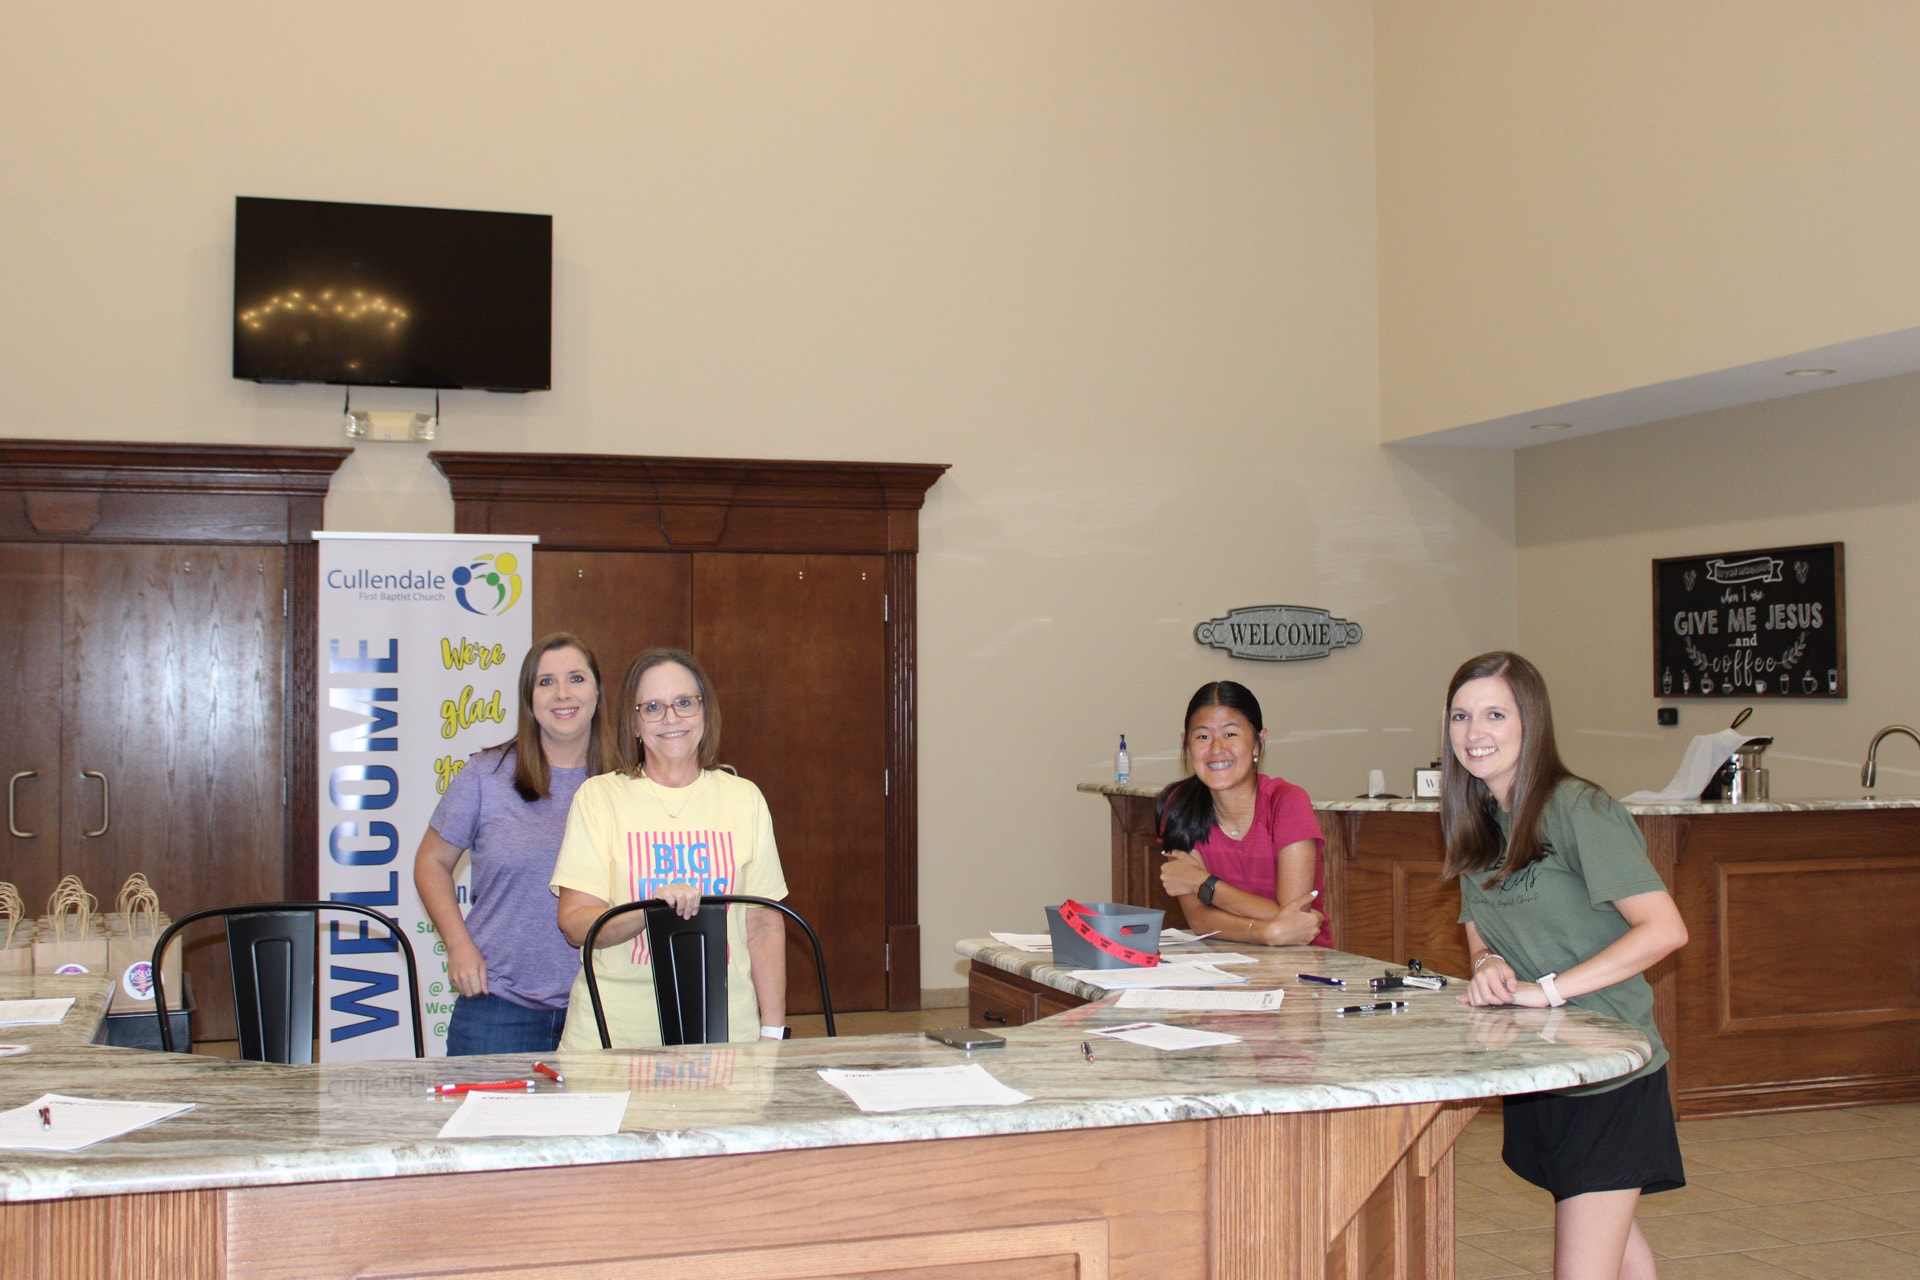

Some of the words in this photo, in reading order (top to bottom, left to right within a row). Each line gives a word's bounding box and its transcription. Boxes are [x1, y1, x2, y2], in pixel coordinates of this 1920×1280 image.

[327, 568, 446, 590] Cullendale
[359, 592, 379, 602] First
[380, 592, 411, 603] Baptist
[412, 592, 445, 602] Church
[1229, 623, 1331, 646] WELCOME
[1673, 609, 1719, 636] GIVE
[1727, 606, 1757, 633] ME
[1764, 602, 1824, 631] JESUS
[440, 636, 506, 671] We're
[1712, 649, 1776, 687] coffee
[440, 685, 506, 740] glad
[329, 638, 399, 1043] WELCOME
[652, 843, 710, 875] BIG
[637, 877, 729, 901] JUS
